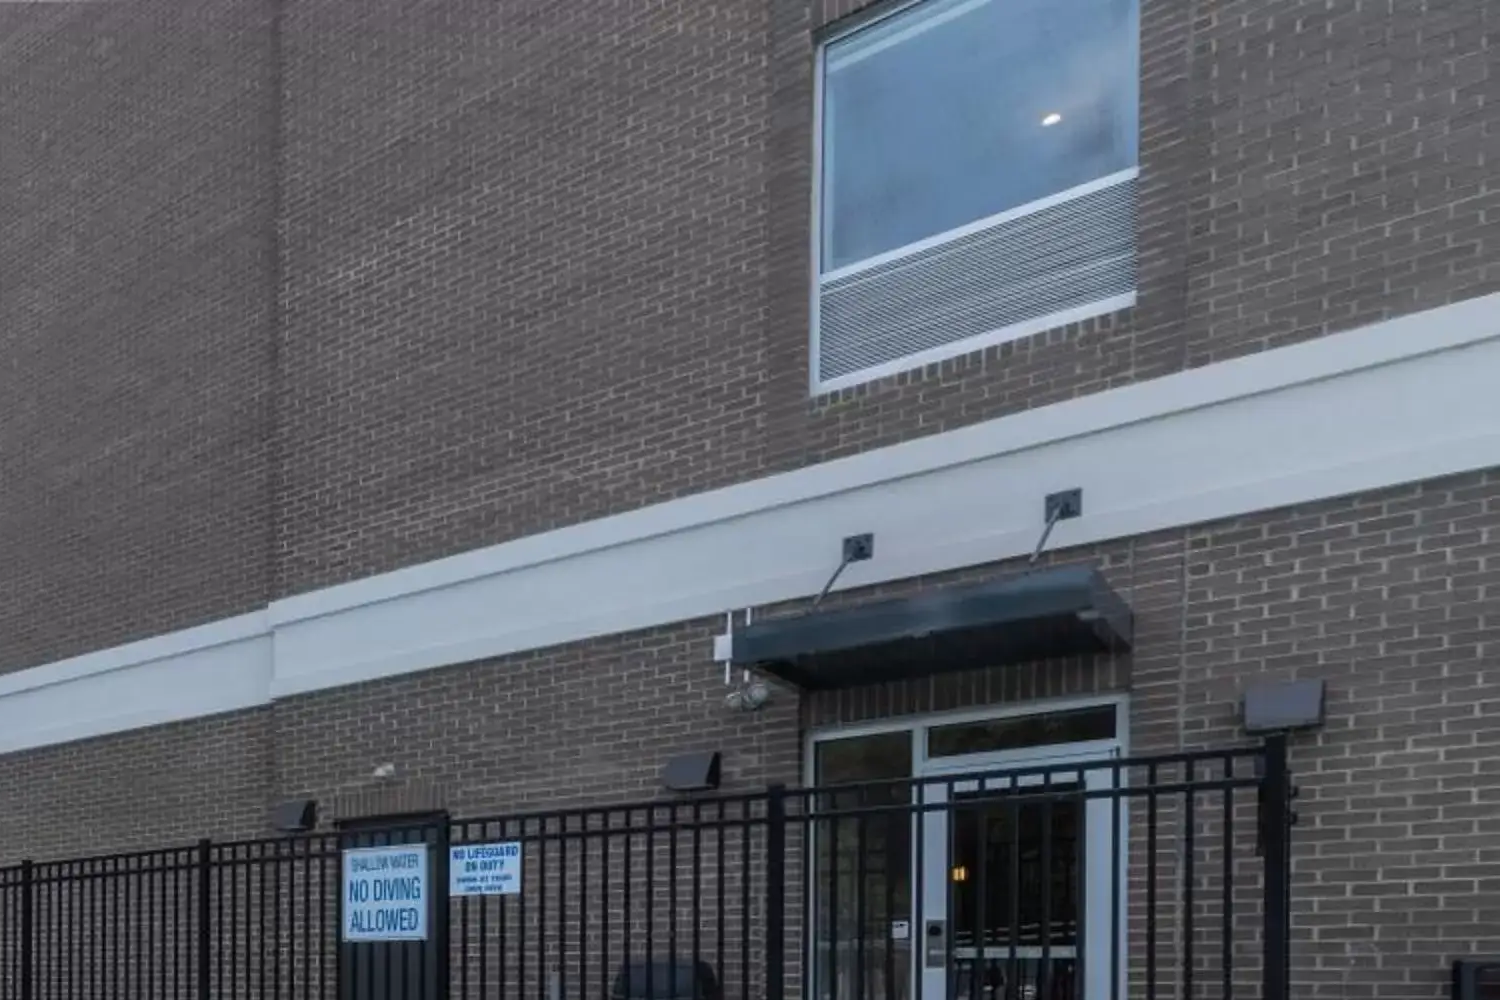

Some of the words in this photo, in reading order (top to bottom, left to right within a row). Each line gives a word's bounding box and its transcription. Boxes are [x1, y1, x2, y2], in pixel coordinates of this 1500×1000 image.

[349, 879, 369, 903] NO
[373, 876, 421, 902] DIVING
[349, 907, 419, 932] ALLOWED
